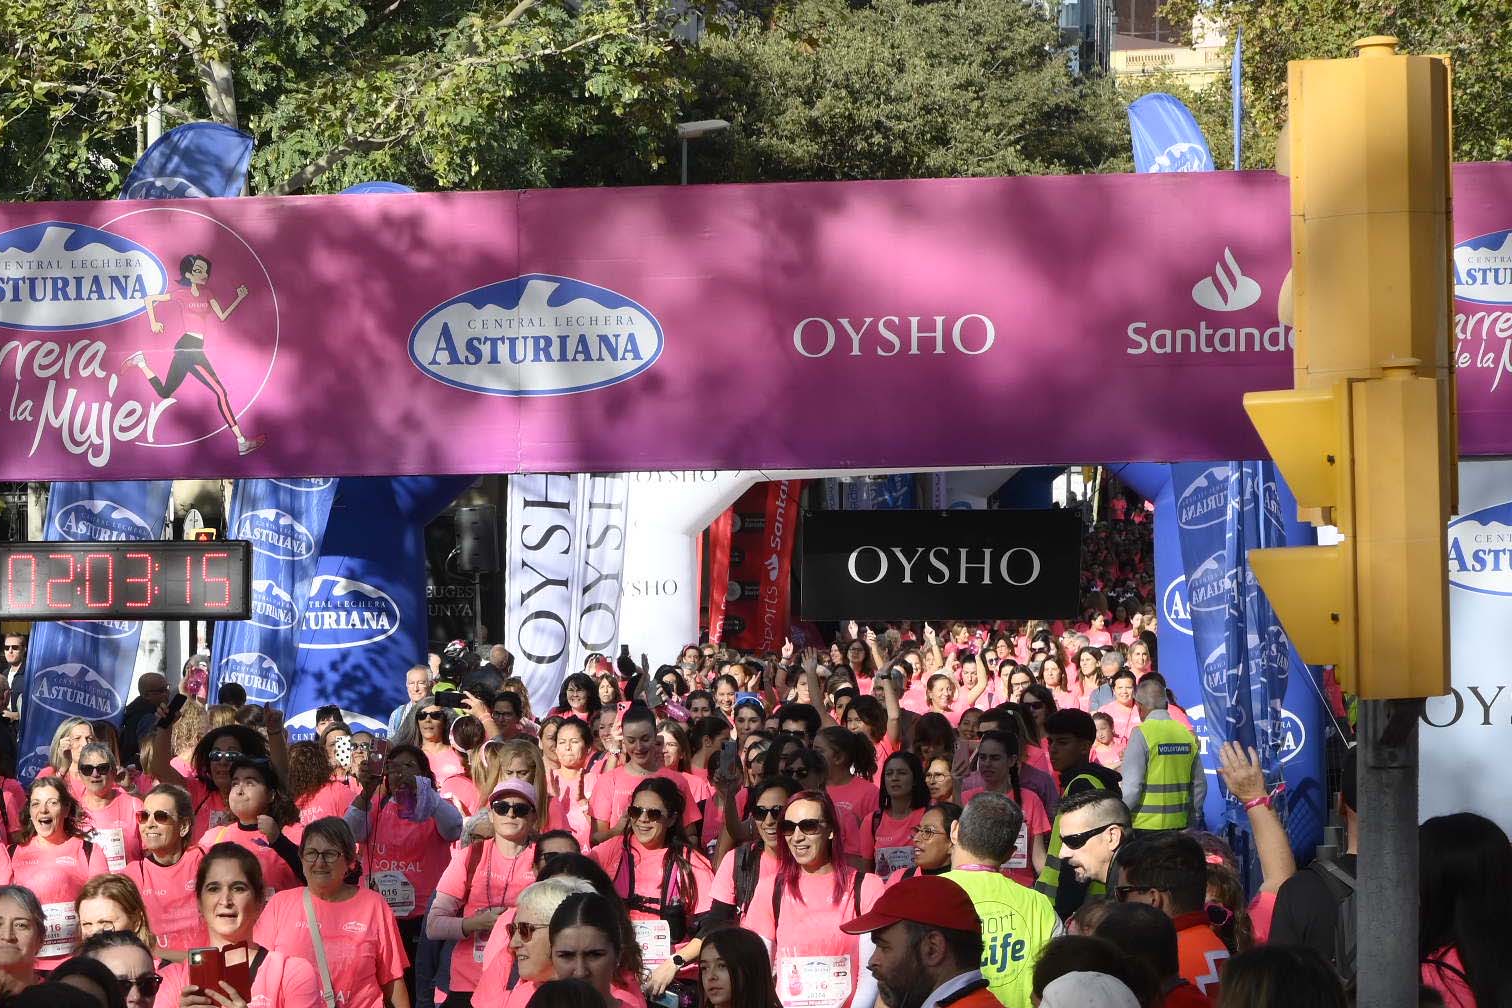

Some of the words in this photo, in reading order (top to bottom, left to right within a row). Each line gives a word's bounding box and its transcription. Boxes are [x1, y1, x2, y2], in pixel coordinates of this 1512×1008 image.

[70, 257, 143, 270] LECHERA
[467, 317, 547, 330] CENTRAL
[554, 314, 636, 328] LECHERA
[792, 313, 996, 359] OYSHO
[1127, 320, 1296, 355] Santand
[428, 321, 644, 367] ASTURIANA
[1476, 340, 1495, 368] la
[9, 382, 33, 422] la
[28, 371, 177, 468] Mujer
[238, 519, 307, 555] ASTURIANA
[7, 552, 230, 609] 02:03:15
[517, 473, 572, 665] OYSH
[577, 473, 624, 652] OYSH
[847, 545, 1041, 586] OYSHO
[337, 599, 386, 608] LECHERA
[36, 676, 113, 714] ASTURIANA
